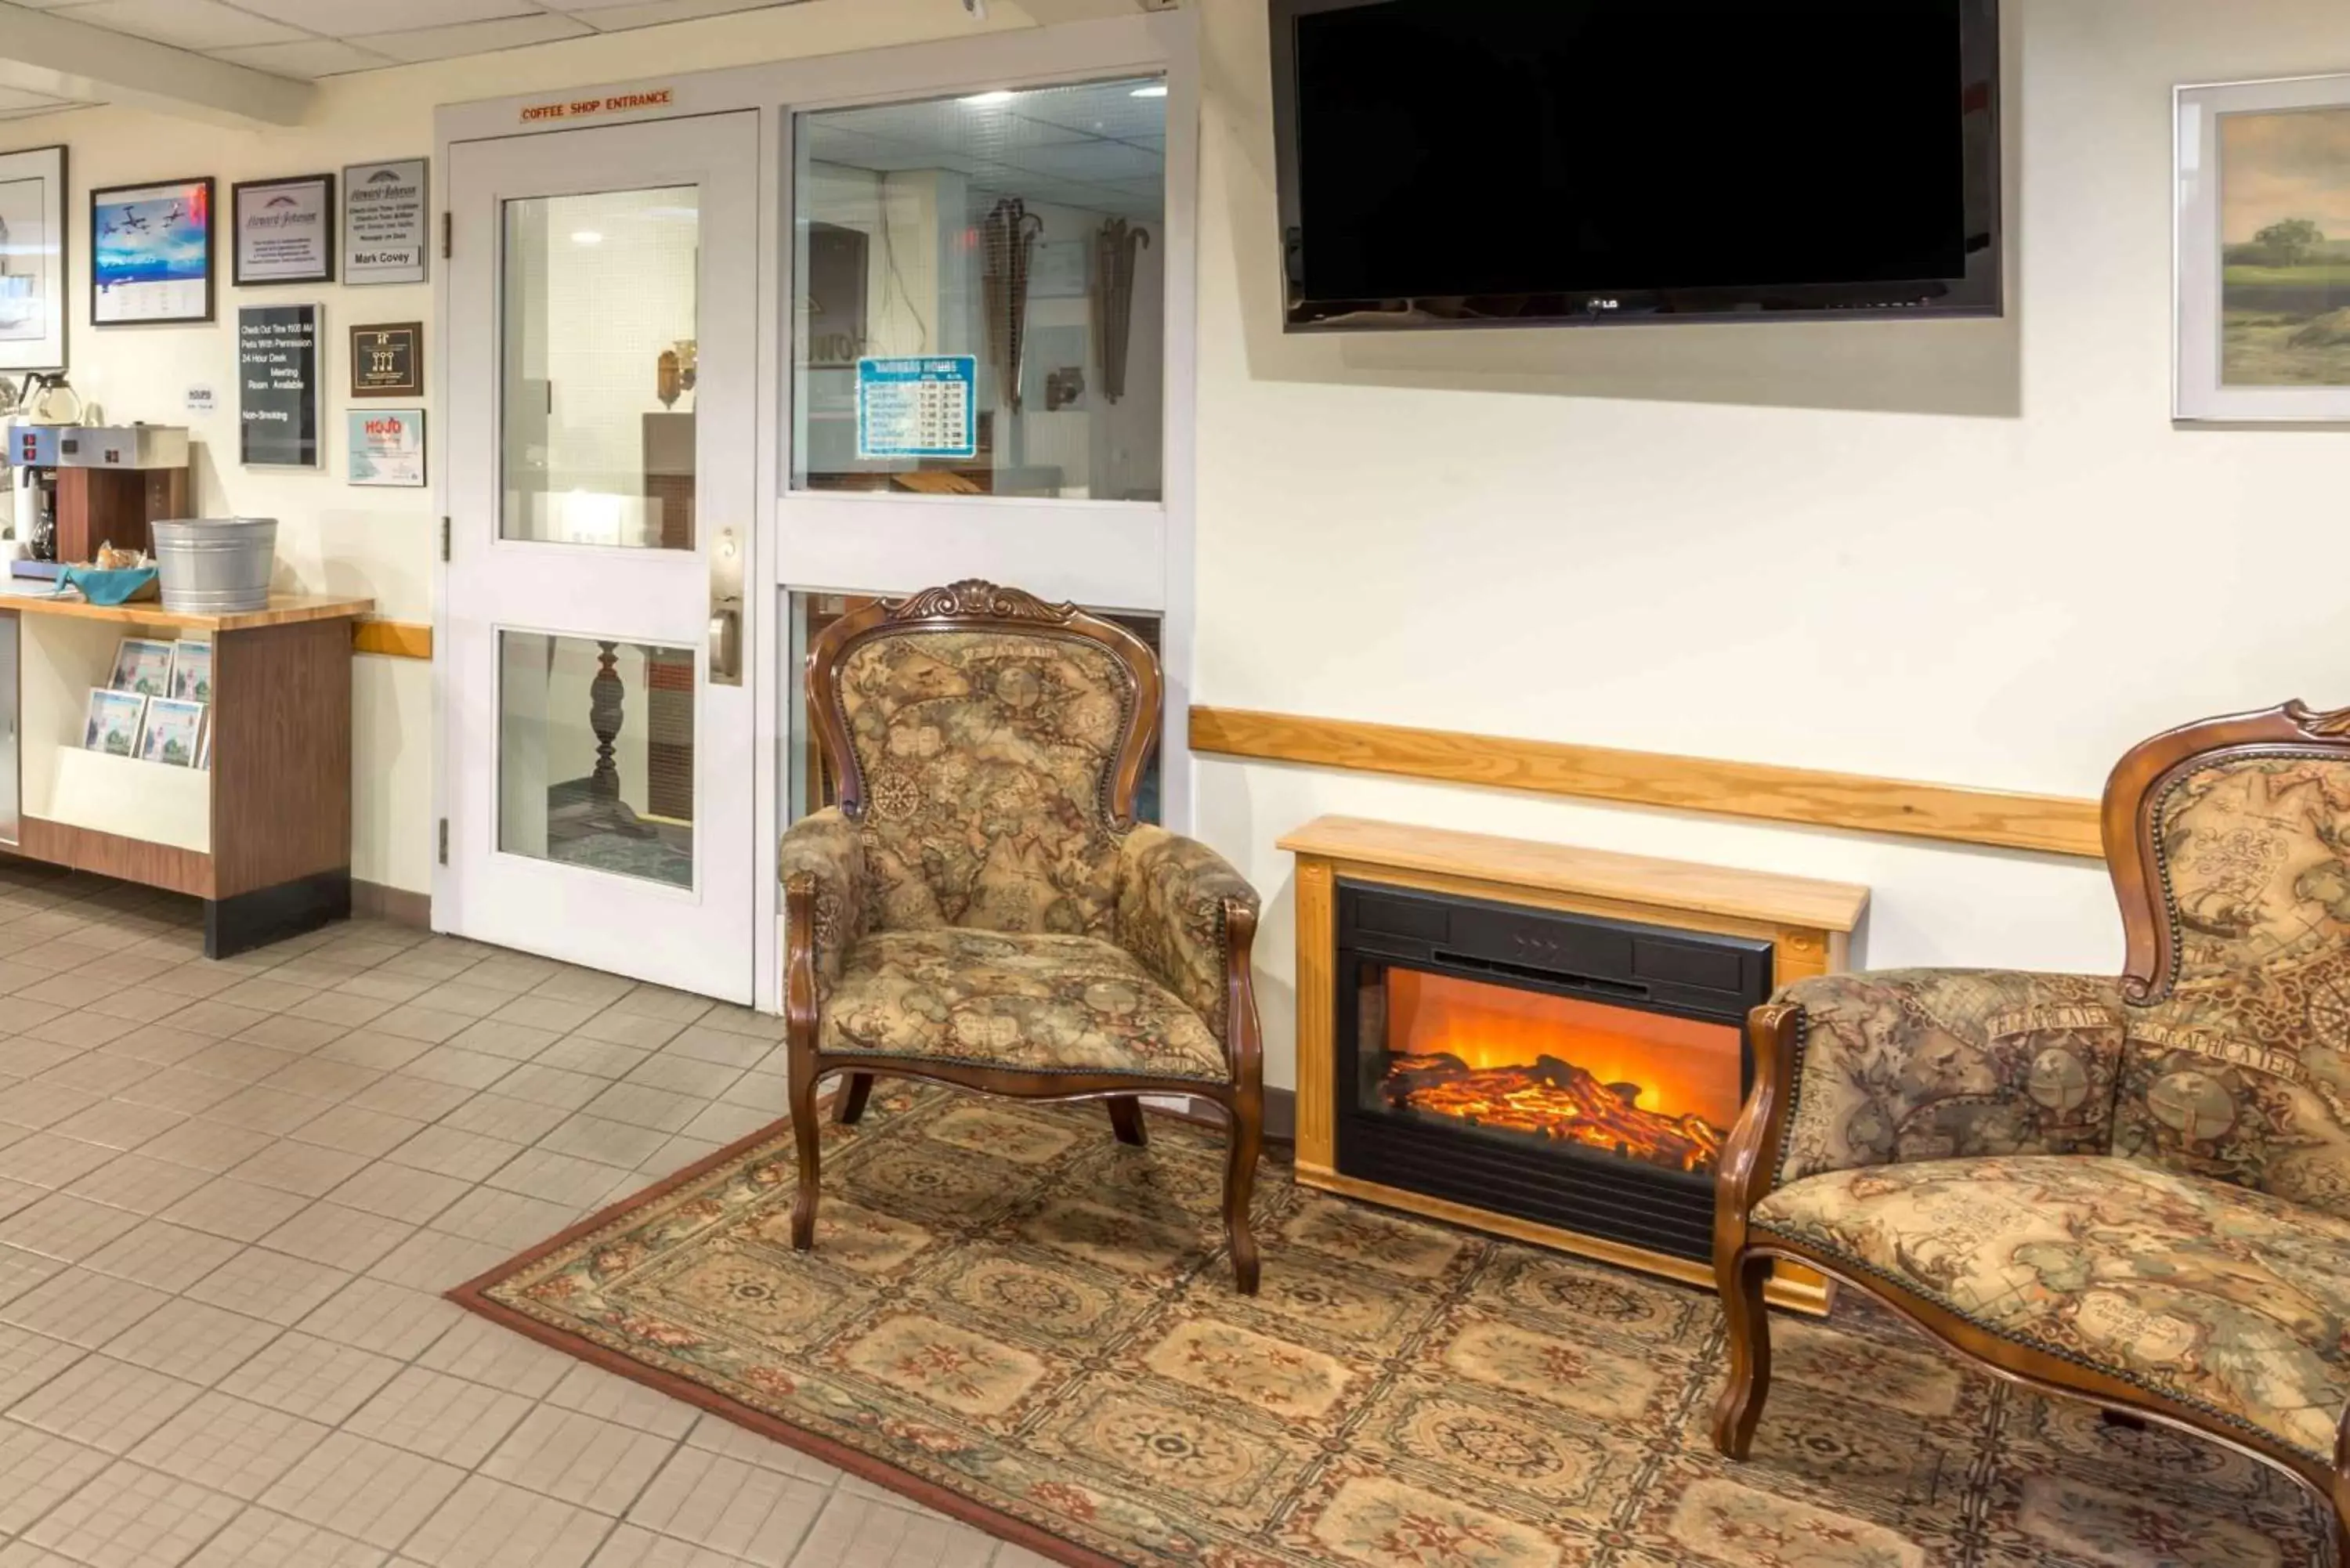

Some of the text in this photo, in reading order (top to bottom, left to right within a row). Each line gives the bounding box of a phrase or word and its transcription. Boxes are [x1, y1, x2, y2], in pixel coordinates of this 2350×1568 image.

[522, 89, 671, 121] COFFEE SHOP ENTRANCE
[355, 252, 410, 264] Mark Covey
[1602, 299, 1618, 309] LG
[240, 325, 259, 334] Check
[260, 325, 272, 334] Out
[273, 323, 287, 334] Time
[241, 338, 313, 349] Pets With Permission
[242, 352, 287, 363] 24 Hour Desk
[270, 366, 299, 378] Meeting
[248, 379, 305, 389] Room Available
[242, 410, 288, 422] Non-Smoking
[364, 418, 402, 434] HOJO
